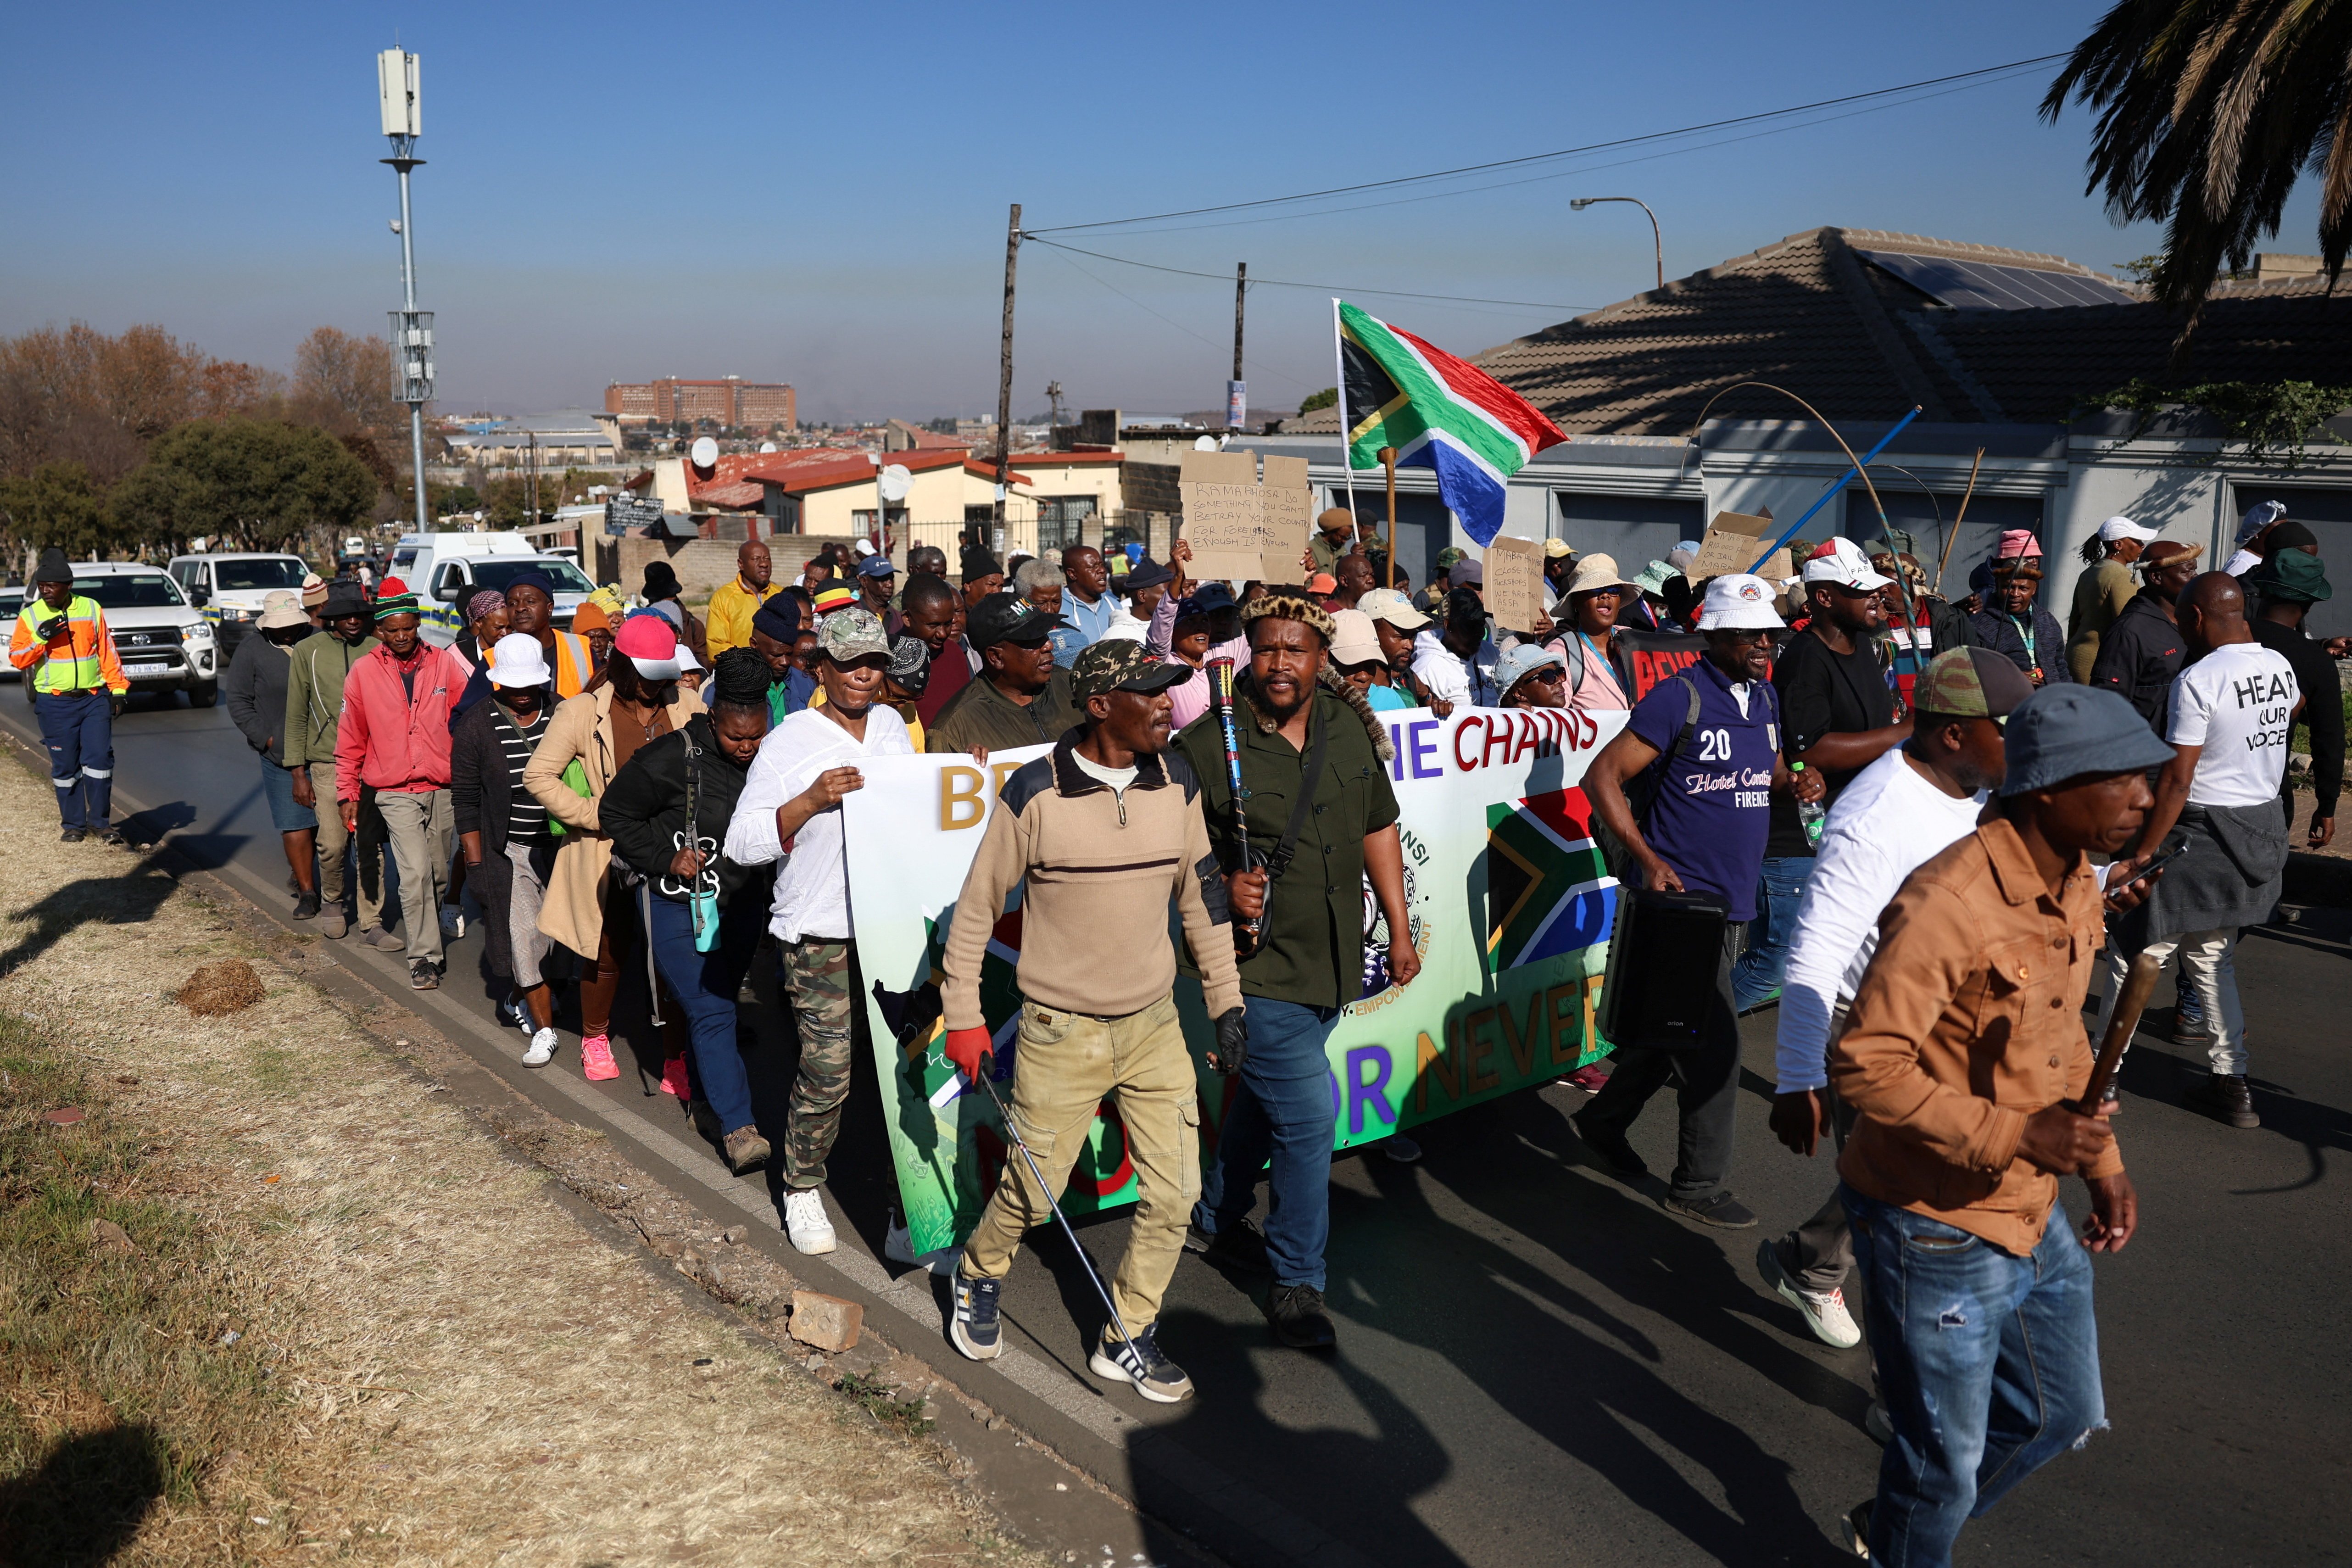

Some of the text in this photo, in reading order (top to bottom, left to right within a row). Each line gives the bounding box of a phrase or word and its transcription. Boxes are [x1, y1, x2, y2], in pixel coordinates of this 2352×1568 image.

[1196, 483, 1298, 503] RAMAPHOSA DO
[1193, 500, 1251, 511] SOMETHING
[1256, 501, 1275, 513] YOU
[1194, 511, 1311, 534] BETRAY YOUR COUNTRY
[1193, 525, 1217, 537] FOR
[1241, 536, 1255, 546] IS
[1496, 549, 1522, 563] MABA
[1717, 553, 1733, 561] JAIL
[1494, 566, 1522, 576] CLOSE
[1493, 578, 1527, 587] TUCKSHOPS
[158, 664, 166, 672] GP
[2259, 706, 2287, 726] OUR
[1455, 709, 1598, 772] CHAINS
[1700, 729, 1732, 760] 20
[1686, 771, 1738, 794] Hotel
[1735, 791, 1770, 808] FIRENZE
